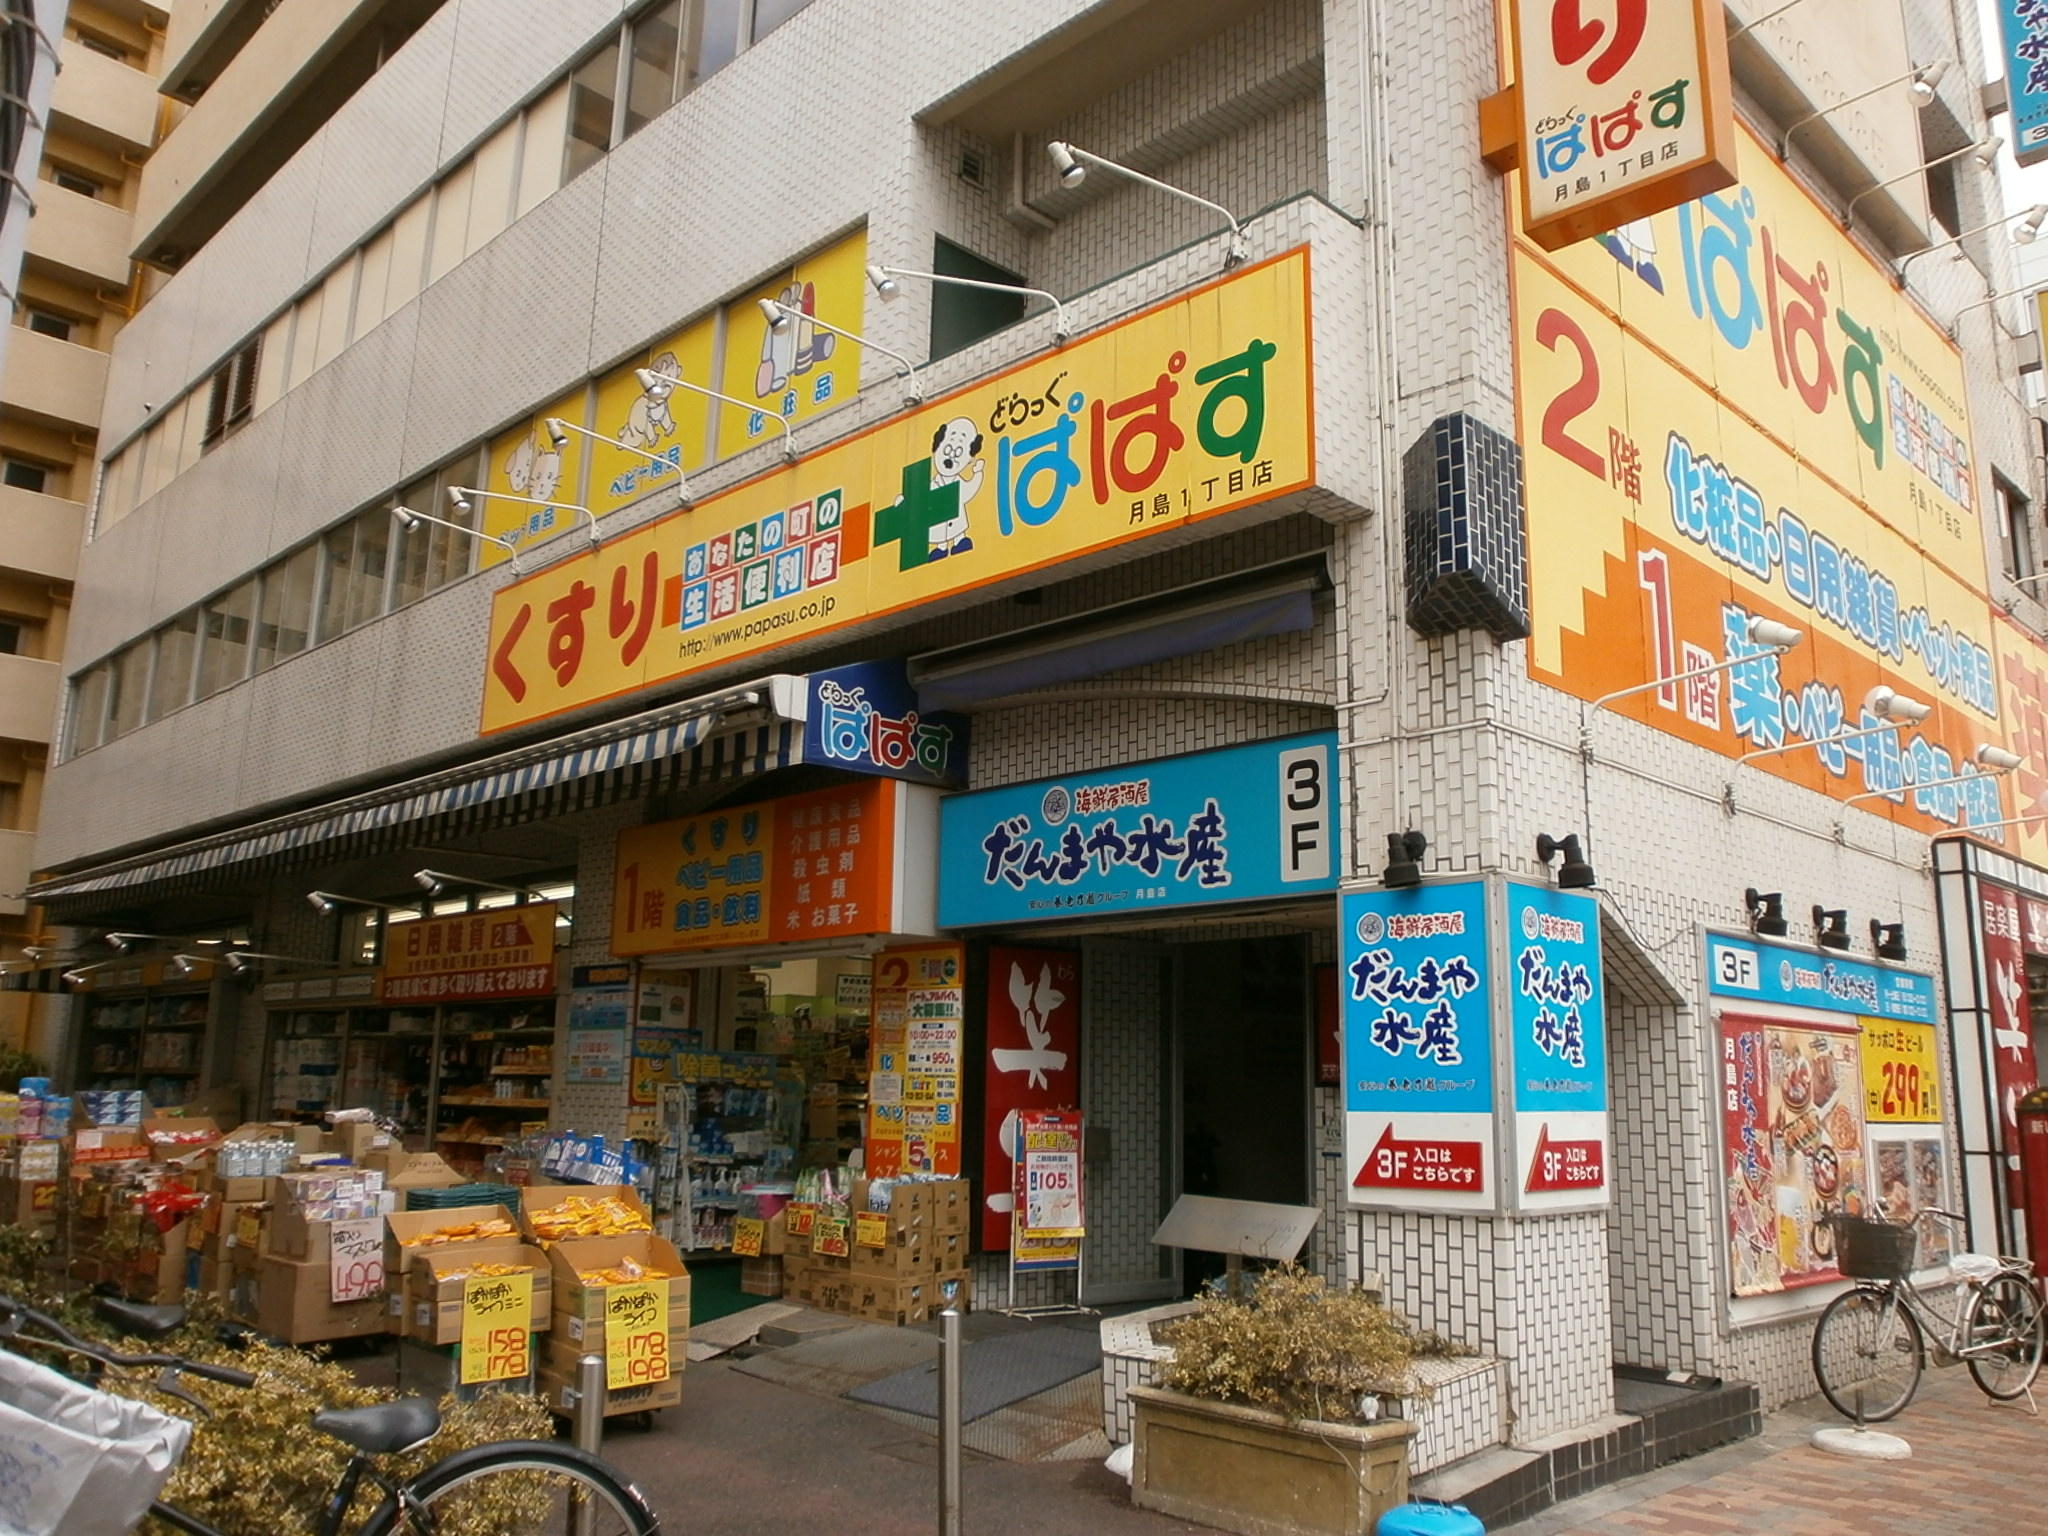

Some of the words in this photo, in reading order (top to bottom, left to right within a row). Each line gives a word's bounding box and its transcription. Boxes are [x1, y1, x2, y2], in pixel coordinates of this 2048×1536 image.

[1535, 105, 1578, 135] どらっぐ
[1536, 79, 1690, 180] ぱぱす
[1554, 140, 1680, 202] 月島1丁目店
[1676, 186, 1885, 470] ぱぱす
[989, 371, 1069, 434] どらっぐ
[996, 339, 1277, 537] ぱぱす
[609, 443, 683, 497] ベビー用品
[1128, 460, 1274, 525] 月島1丁目店
[684, 492, 841, 580] あなたの町の
[682, 538, 839, 629] 生活便利店
[493, 550, 659, 704] くすり
[679, 595, 836, 659] http://www.papasu.co.jp
[819, 680, 865, 707] どらっぐ
[822, 702, 954, 778] ぱぱす
[1075, 779, 1150, 816] 海鮮居酒屋
[1286, 758, 1321, 871] 3F
[681, 811, 762, 855] くすり
[982, 798, 1232, 890] だんまや水産
[675, 852, 763, 890] ベビー用品
[792, 850, 855, 880] 殺虫剤
[674, 892, 761, 932] 食品・飲料
[1387, 911, 1465, 940] 海鮮居酒屋
[1349, 948, 1480, 1006] だんまや
[1518, 945, 1594, 1006] だんまや
[1722, 951, 1752, 985] 3F
[1370, 999, 1463, 1065] 水産
[1533, 1003, 1586, 1069] 水産
[1882, 1061, 1919, 1117] 299
[1376, 1148, 1408, 1179] 3F
[1412, 1166, 1476, 1183] こちらです
[1413, 1147, 1453, 1163] 入口は
[1543, 1150, 1563, 1182] 3F
[1566, 1147, 1588, 1162] 入口は
[1566, 1166, 1600, 1182] こちらです
[1039, 1171, 1068, 1190] 105
[488, 1328, 527, 1353] 158
[627, 1331, 667, 1358] 178
[487, 1353, 527, 1379] 178
[627, 1357, 667, 1384] 198
